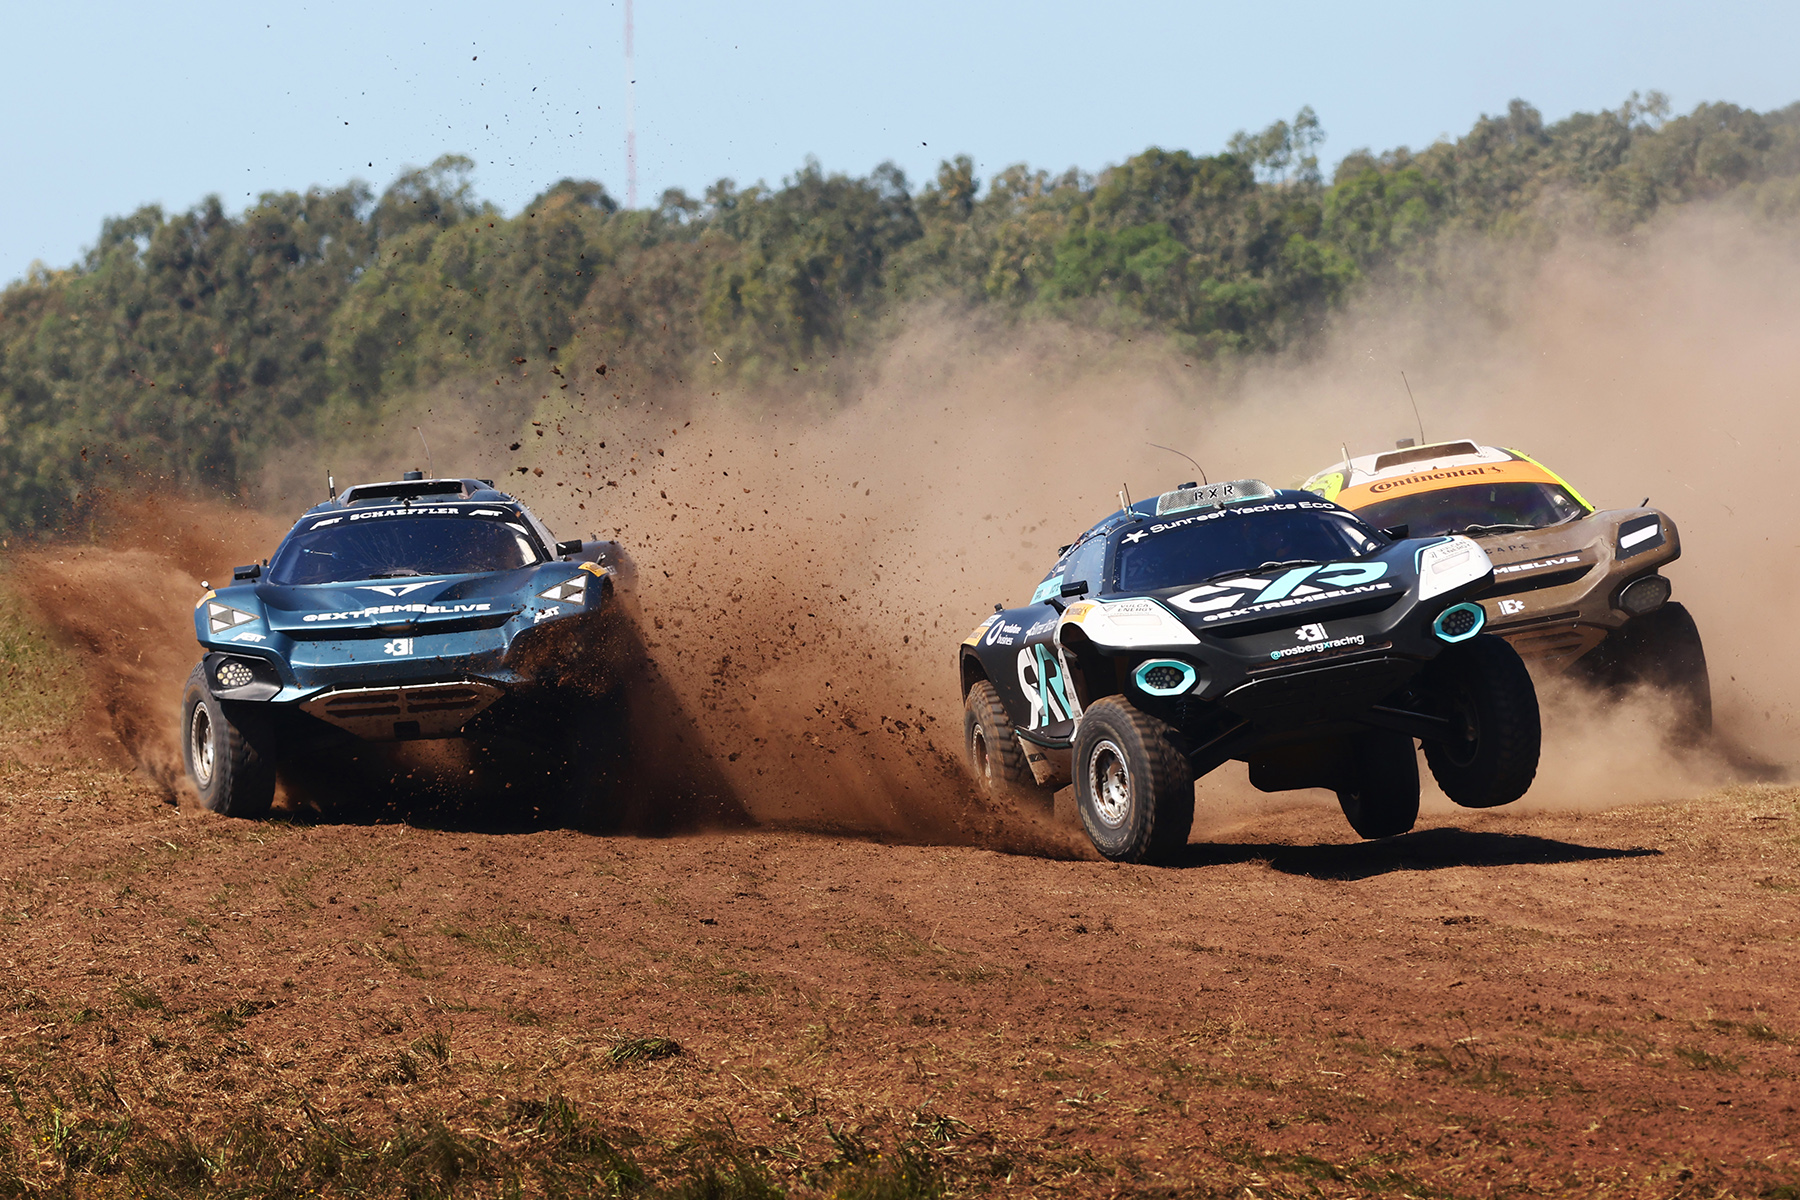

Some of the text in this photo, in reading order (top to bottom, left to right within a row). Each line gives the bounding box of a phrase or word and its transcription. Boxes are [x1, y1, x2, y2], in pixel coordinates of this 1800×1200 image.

[1369, 467, 1485, 493] Continental
[1194, 485, 1235, 501] RXR
[350, 508, 459, 521] SCHAEFFLER
[469, 509, 503, 517] ABT
[1150, 501, 1336, 533] Sunreef Yachts Eco
[309, 517, 343, 531] ABT
[1202, 582, 1392, 622] @EXTREMEELIVE
[303, 603, 491, 622] @EXTREMEELIVE
[231, 632, 267, 643] ABT
[1270, 634, 1365, 661] @rosbergxracing
